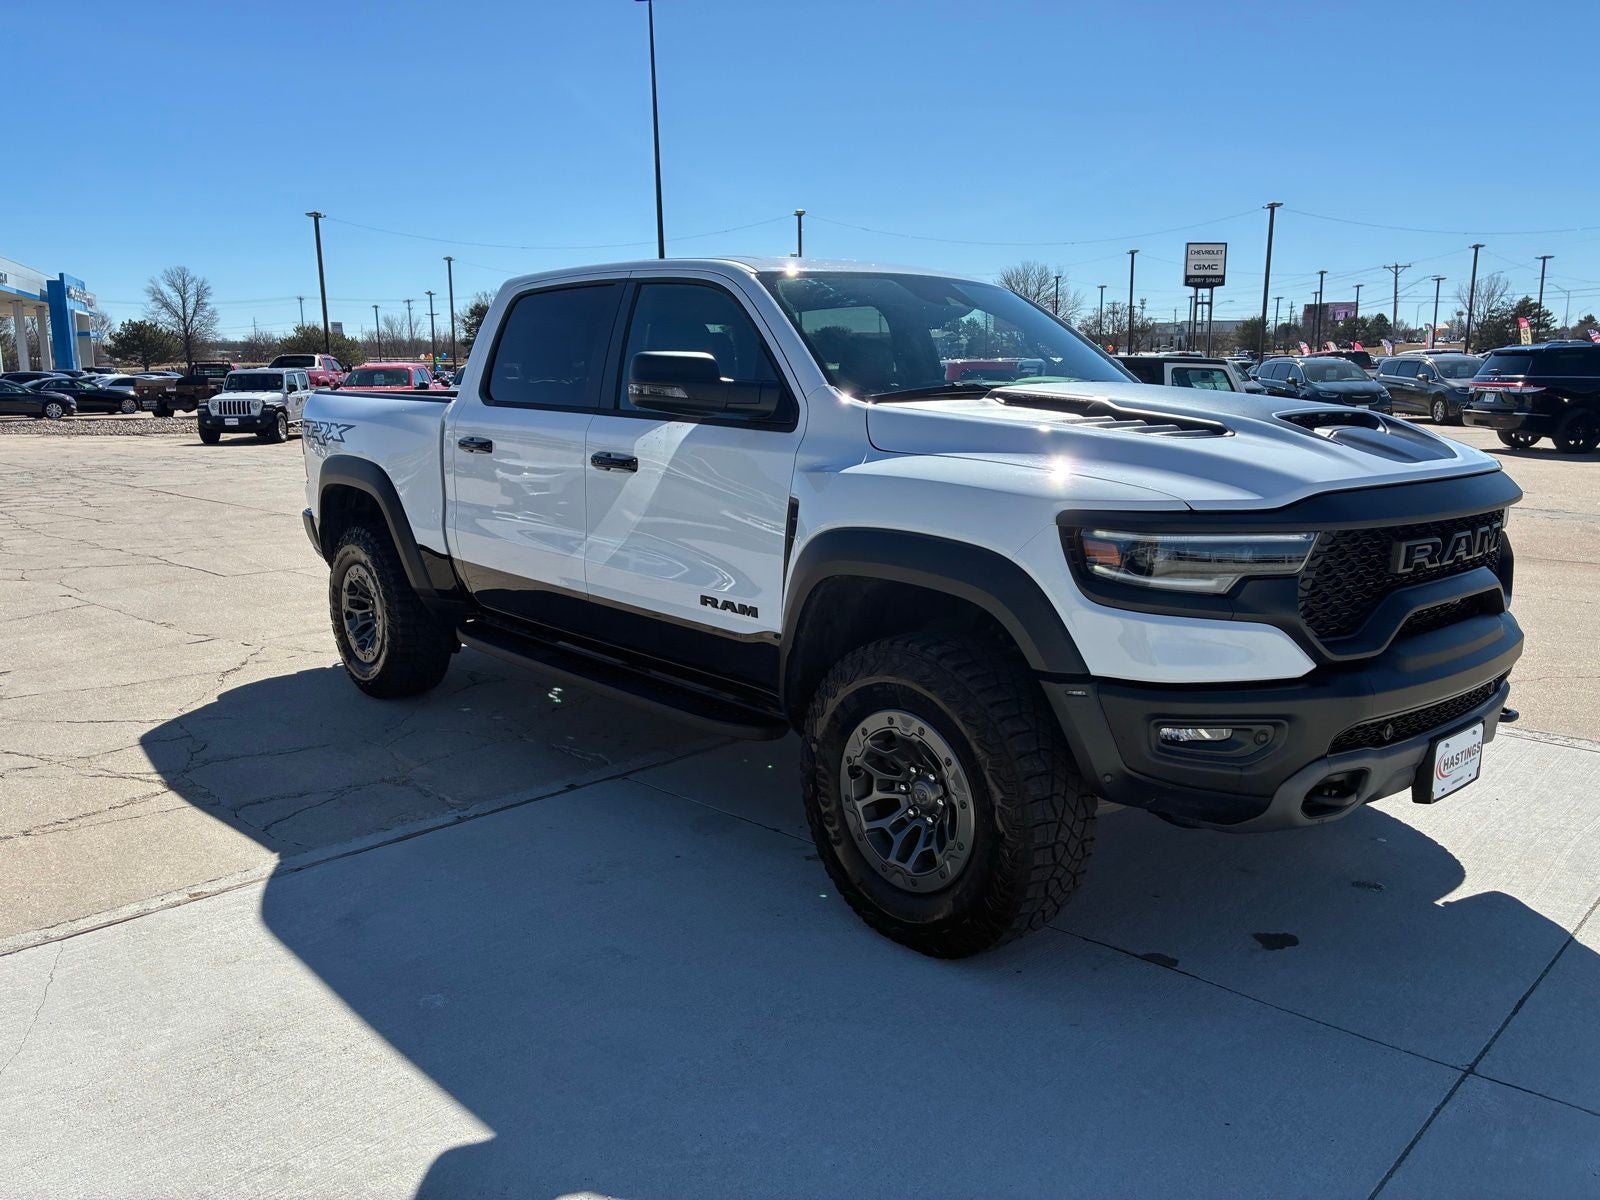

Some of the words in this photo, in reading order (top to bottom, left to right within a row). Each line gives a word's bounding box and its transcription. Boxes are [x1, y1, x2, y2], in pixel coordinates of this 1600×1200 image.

[1193, 263, 1219, 271] GMC
[304, 420, 356, 446] TRX
[1396, 521, 1501, 573] RAM
[700, 594, 758, 618] RAM
[1442, 741, 1481, 772] HASTINGS
